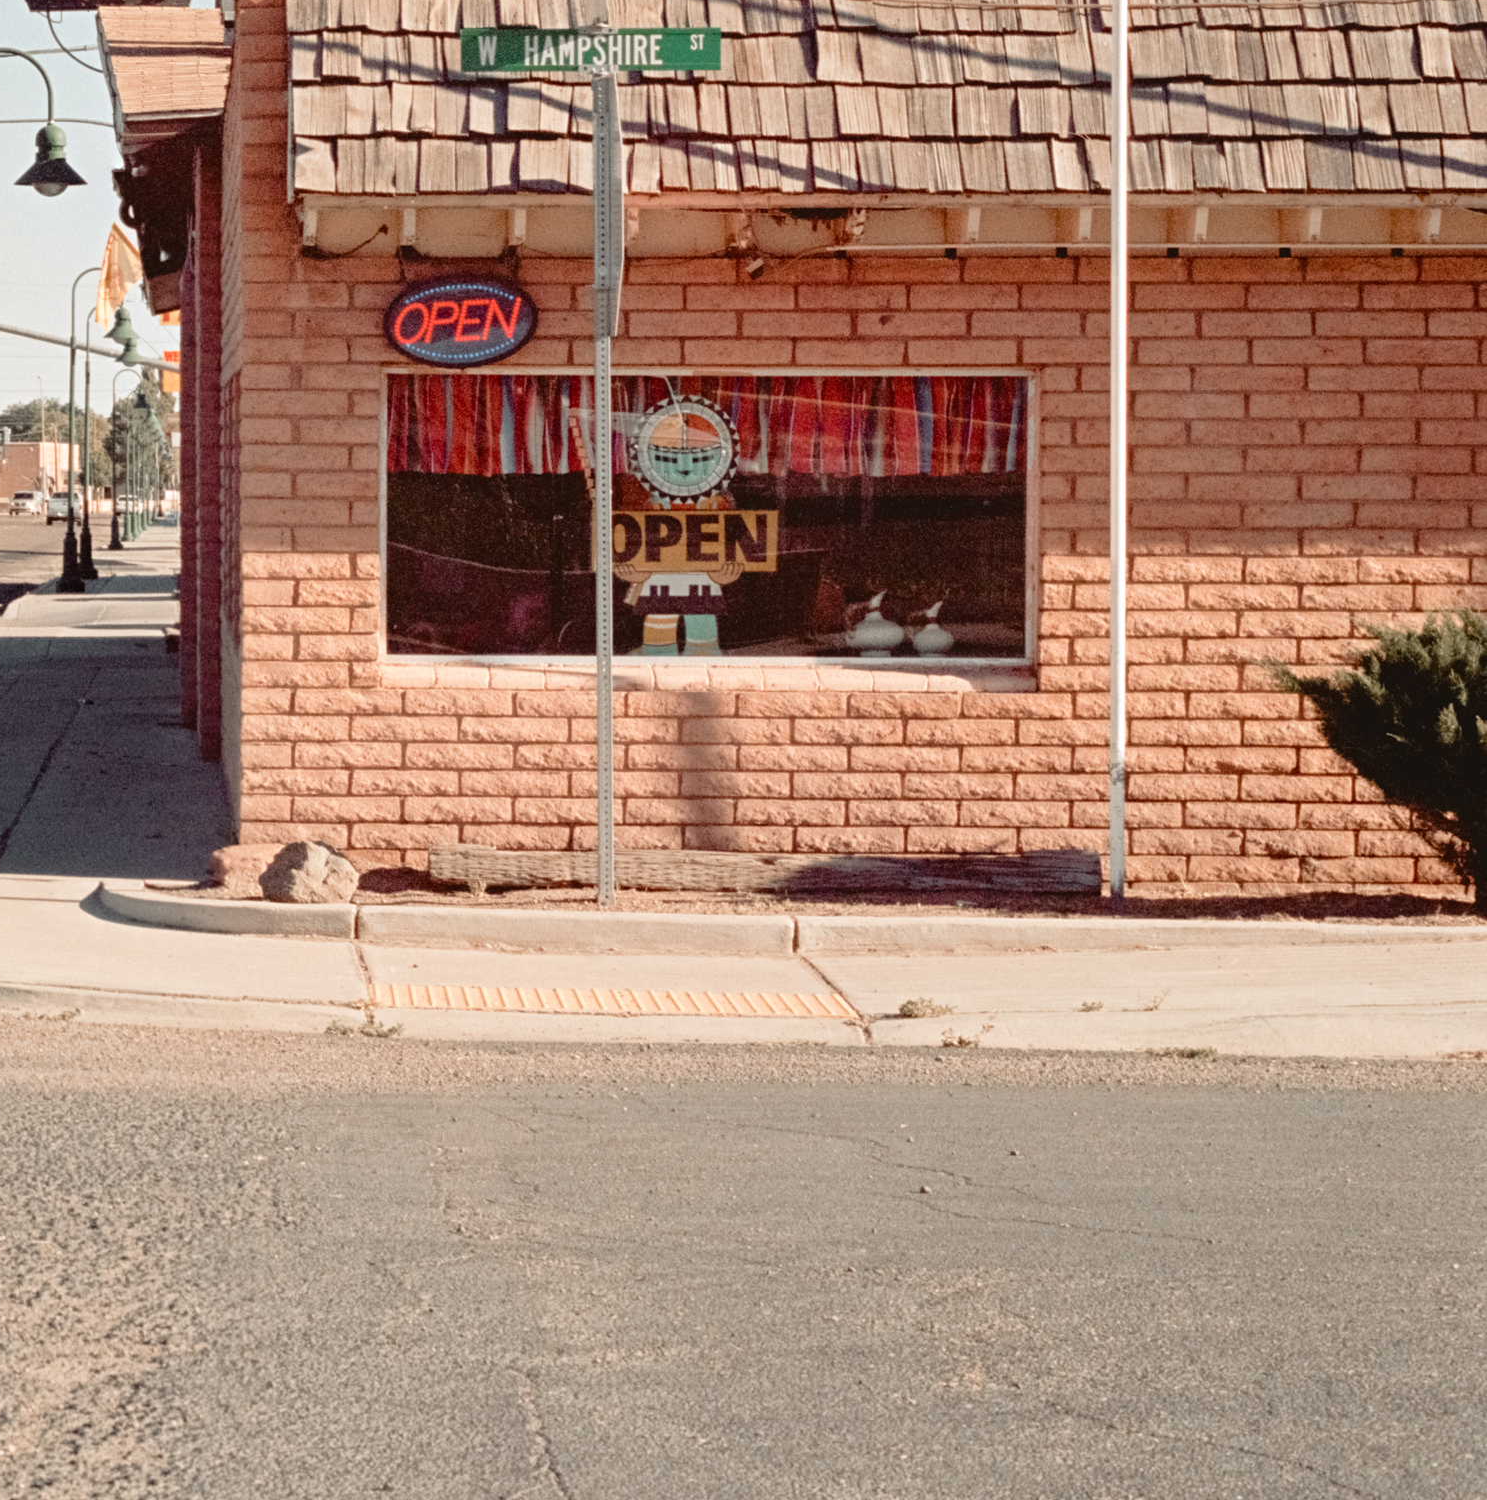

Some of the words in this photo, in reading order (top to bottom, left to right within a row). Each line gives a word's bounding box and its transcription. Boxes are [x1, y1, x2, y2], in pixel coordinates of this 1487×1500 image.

[478, 35, 498, 66] W
[524, 34, 663, 66] HAMPSHIRE
[690, 34, 705, 50] ST
[394, 297, 521, 345] OPEN
[612, 513, 767, 563] OPEN
